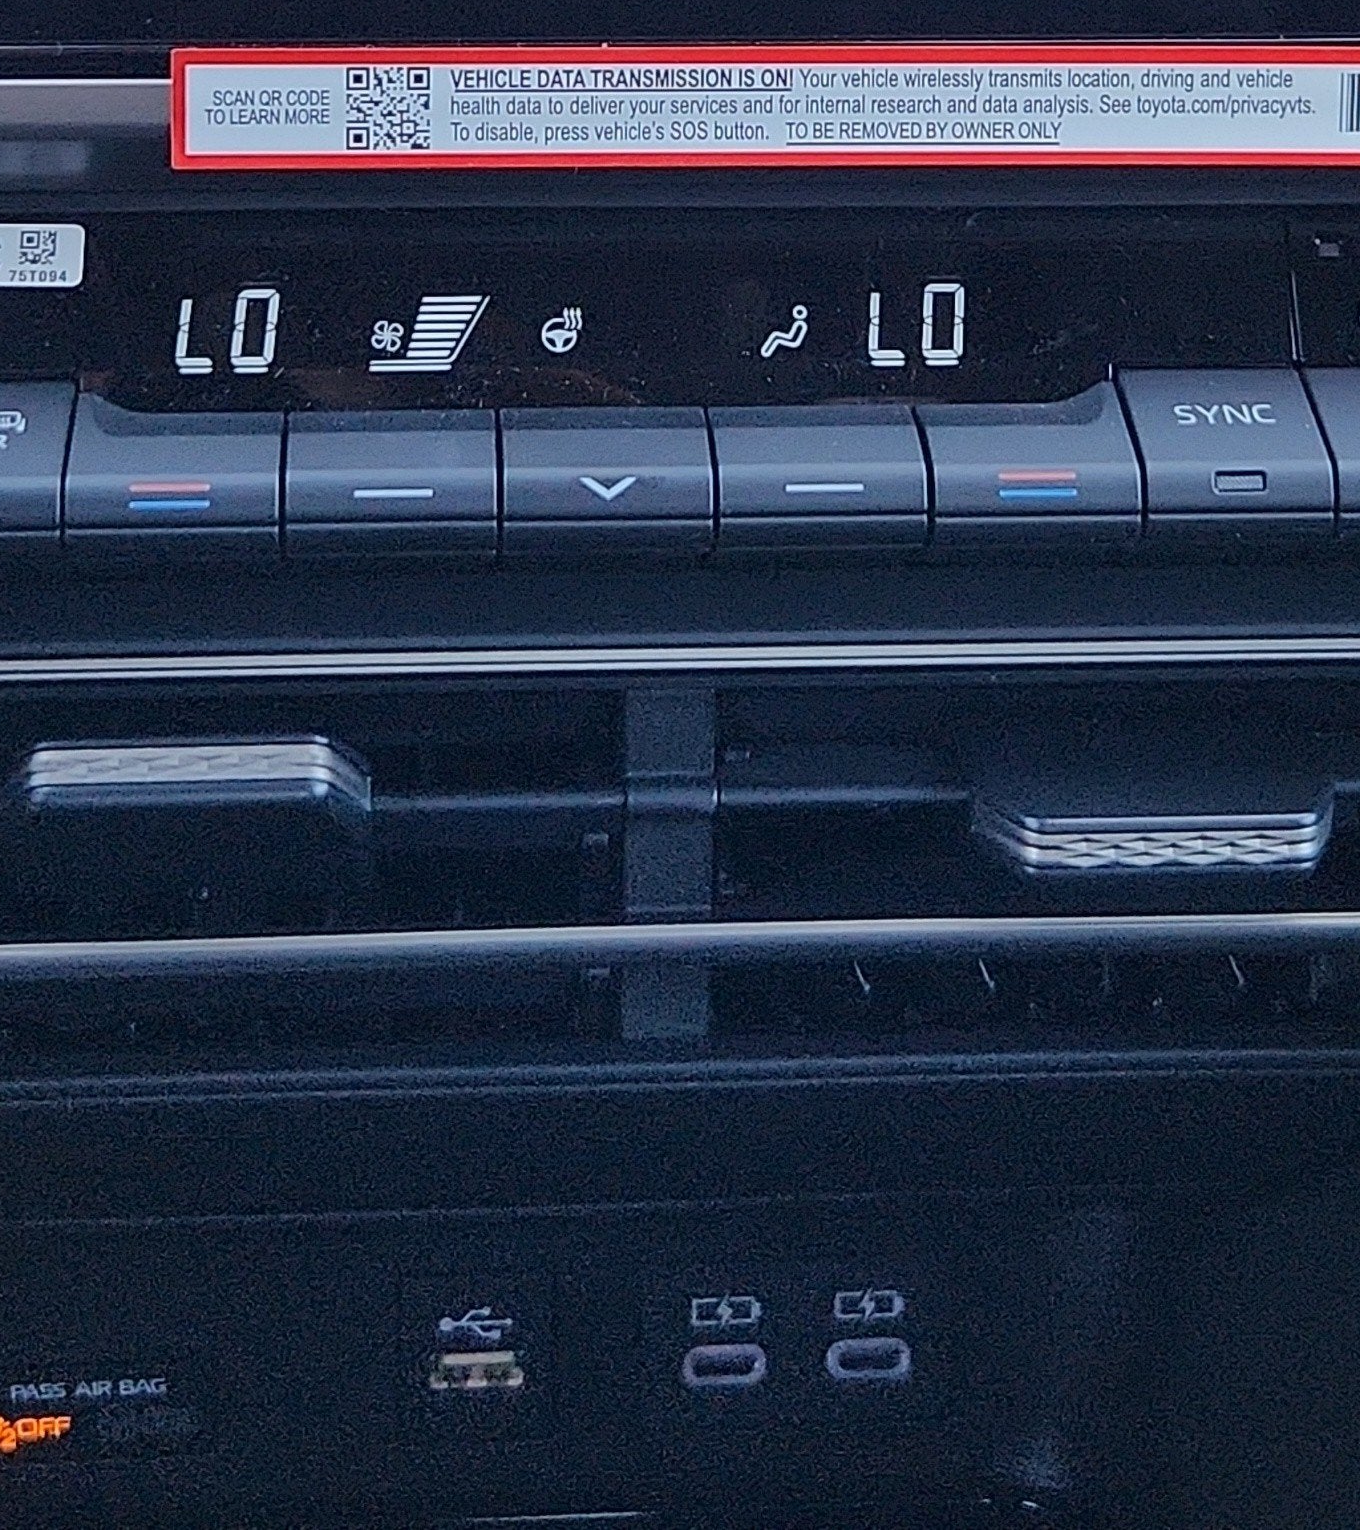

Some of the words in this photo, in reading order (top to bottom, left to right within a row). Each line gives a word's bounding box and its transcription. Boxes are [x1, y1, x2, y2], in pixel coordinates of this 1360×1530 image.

[450, 69, 532, 88] VEHICLE
[537, 69, 586, 88] DATA
[590, 68, 732, 88] TRANSMISSION
[739, 68, 755, 88] IS
[761, 68, 793, 88] ON!
[800, 68, 837, 88] Your
[841, 68, 899, 88] vehicle
[903, 68, 984, 92] wirelessly
[989, 68, 1063, 88] transmits
[1067, 68, 1135, 91] location,
[1140, 68, 1195, 93] driving
[1199, 68, 1232, 88] and
[1236, 68, 1294, 88] vehicle
[212, 89, 255, 107] SCAN
[259, 89, 282, 108] QR
[286, 89, 331, 107] CODE
[450, 95, 501, 116] health
[505, 95, 542, 116] data
[548, 96, 564, 116] to
[569, 95, 625, 116] deliver
[629, 99, 666, 120] your
[670, 94, 738, 115] services
[742, 94, 774, 115] and
[778, 94, 801, 115] for
[805, 94, 866, 115] internal
[870, 94, 941, 114] research
[946, 94, 978, 114] and
[982, 94, 1019, 114] data
[1022, 94, 1094, 119] analysis.
[1098, 94, 1132, 115] See
[1136, 94, 1317, 120] toyota.com/privacyvts.
[204, 108, 226, 125] TO
[229, 108, 281, 125] LEARN
[284, 108, 331, 125] MORE
[450, 121, 470, 141] To
[474, 121, 539, 145] disable,
[544, 125, 590, 146] press
[594, 121, 666, 141] vehicle's
[670, 121, 709, 141] SOS
[713, 121, 770, 141] button.
[785, 122, 808, 140] TO
[812, 122, 835, 140] BE
[839, 122, 922, 140] REMOVED
[926, 122, 948, 139] BY
[951, 121, 1015, 139] OWNER
[1018, 121, 1062, 139] ONLY
[1173, 402, 1277, 426] SYNC
[10, 1381, 67, 1402] PASS
[74, 1379, 112, 1398] AIR
[118, 1377, 168, 1396] BAG
[15, 1416, 73, 1442] OFF
